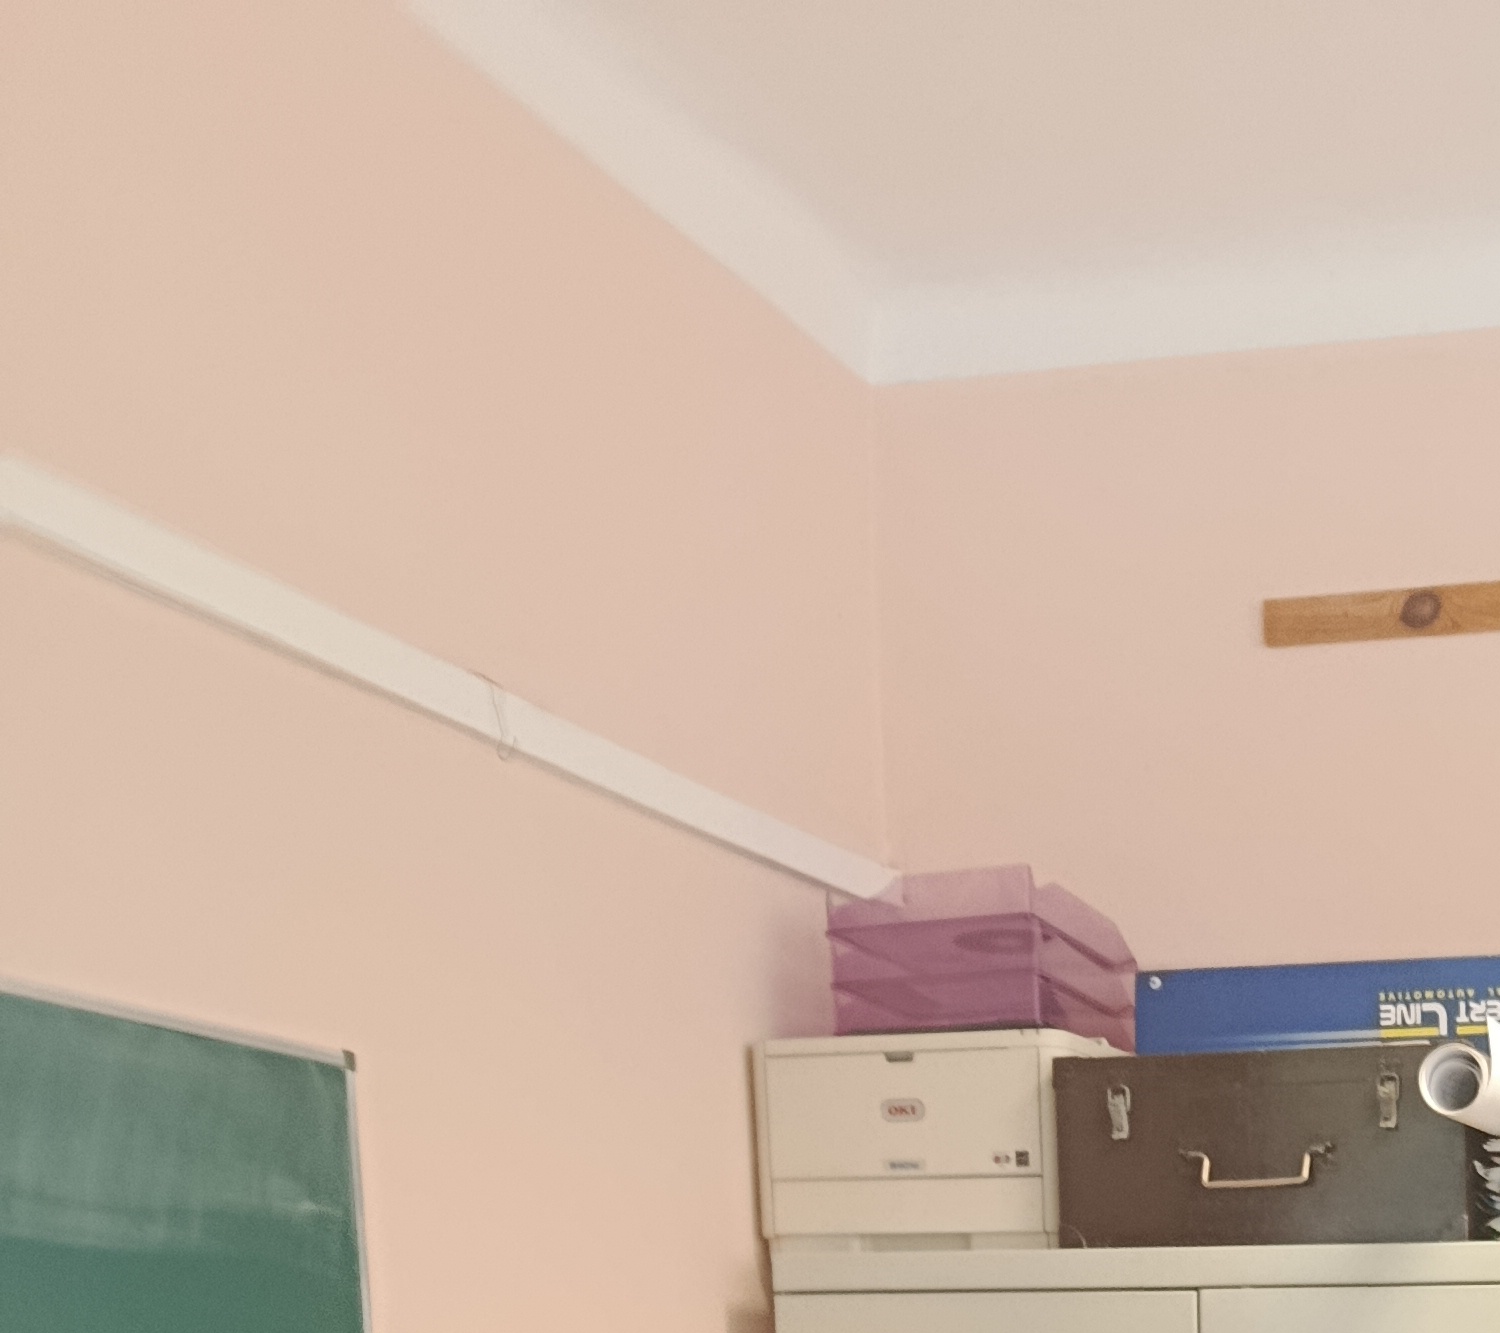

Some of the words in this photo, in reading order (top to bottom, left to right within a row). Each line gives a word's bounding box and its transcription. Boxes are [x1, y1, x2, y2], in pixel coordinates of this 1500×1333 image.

[1379, 988, 1475, 1001] AUTOMOTIVE
[1379, 1002, 1448, 1036] LINE
[887, 1105, 916, 1117] OKI
